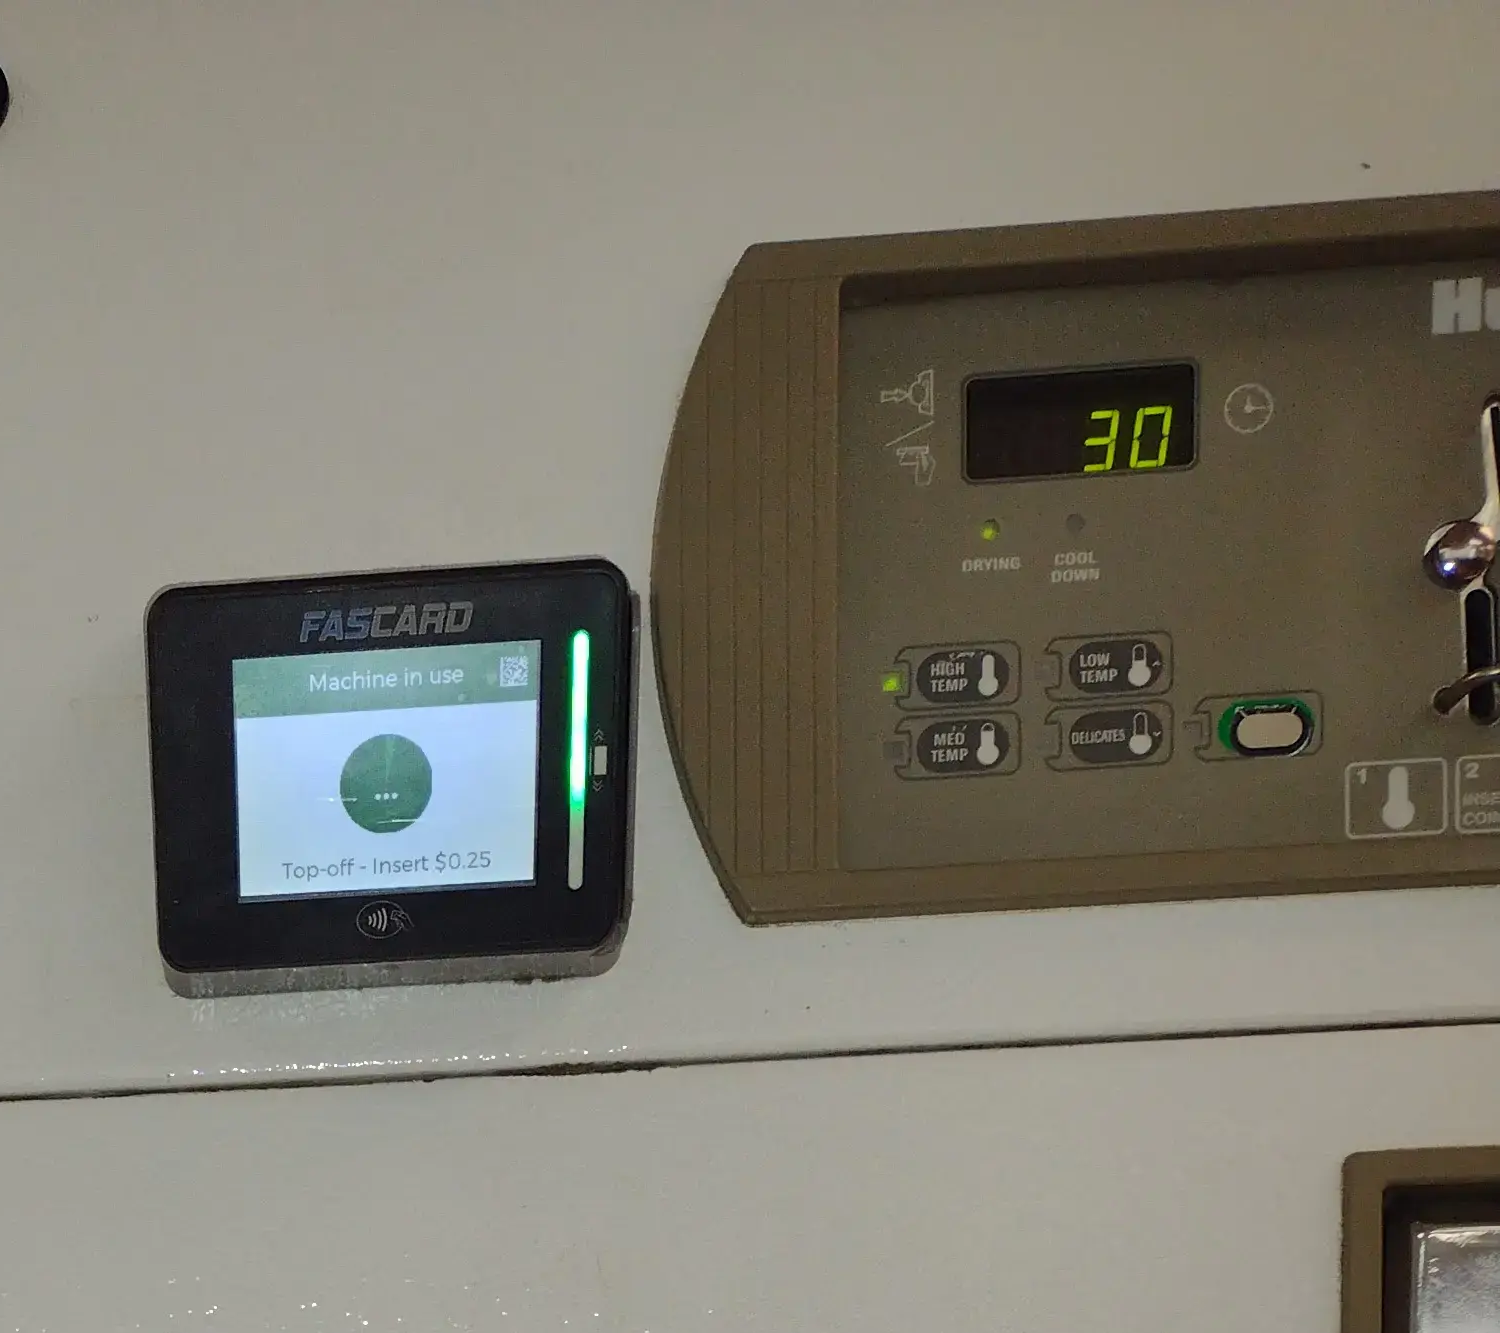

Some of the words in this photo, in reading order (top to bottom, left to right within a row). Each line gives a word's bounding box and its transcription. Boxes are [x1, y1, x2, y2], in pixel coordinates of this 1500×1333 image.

[1084, 406, 1172, 472] 30
[962, 556, 1021, 572] DRYING
[1055, 551, 1098, 566] COOL
[1051, 568, 1100, 583] DOWN
[300, 601, 473, 643] FASCARD
[1079, 653, 1111, 668] LOW
[930, 662, 966, 676] HIGH
[1080, 668, 1118, 683] TEMP
[309, 670, 398, 692] Machine
[404, 667, 422, 686] in
[430, 667, 464, 684] use
[931, 678, 968, 693] TEMP
[934, 732, 965, 746] MED
[1071, 728, 1126, 745] DELICATES
[931, 748, 969, 763] TEMP
[1356, 768, 1368, 784] 1
[1464, 762, 1480, 779] 2
[282, 858, 355, 882] Top-off
[373, 855, 429, 875] Insert
[435, 851, 491, 873] $0.25
